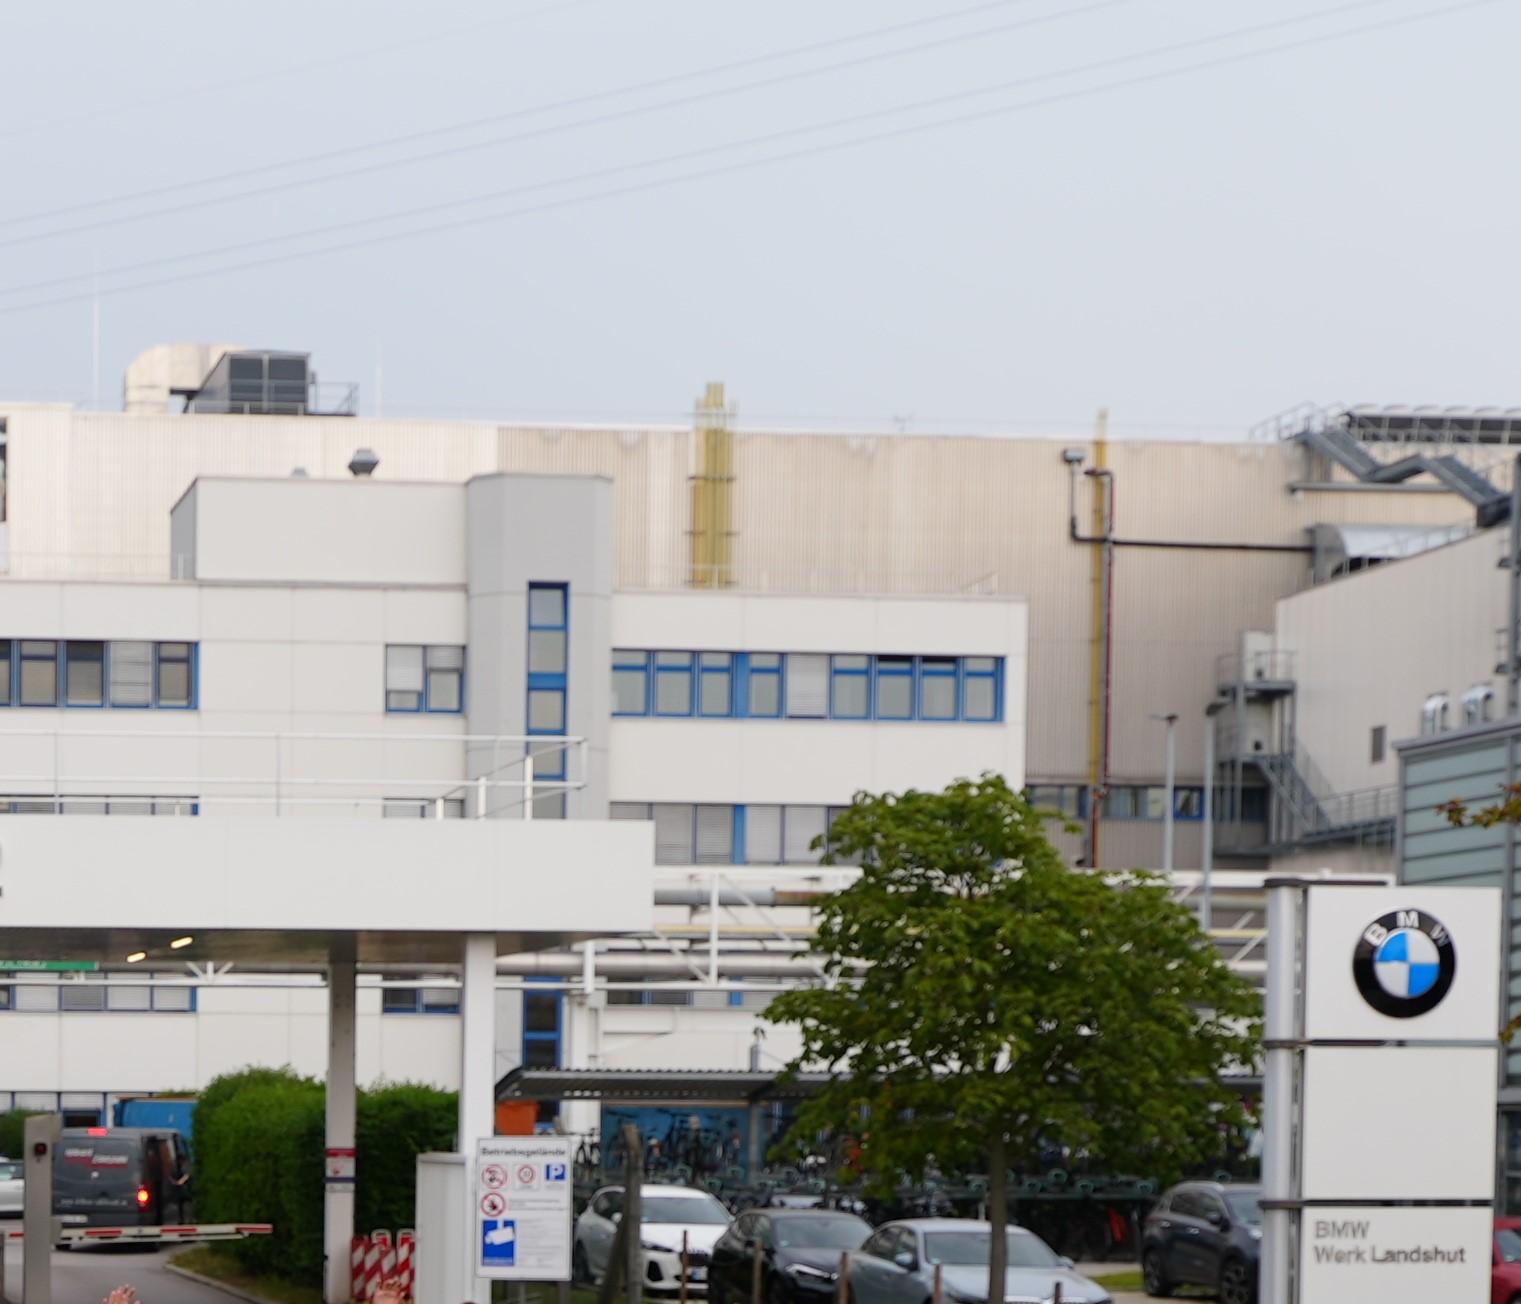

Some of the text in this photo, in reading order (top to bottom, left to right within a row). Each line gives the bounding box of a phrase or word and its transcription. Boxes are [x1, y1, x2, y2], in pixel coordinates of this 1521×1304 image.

[1364, 909, 1450, 947] BMW
[1314, 1220, 1371, 1240] BMW
[1313, 1244, 1466, 1264] Werk Landshut
